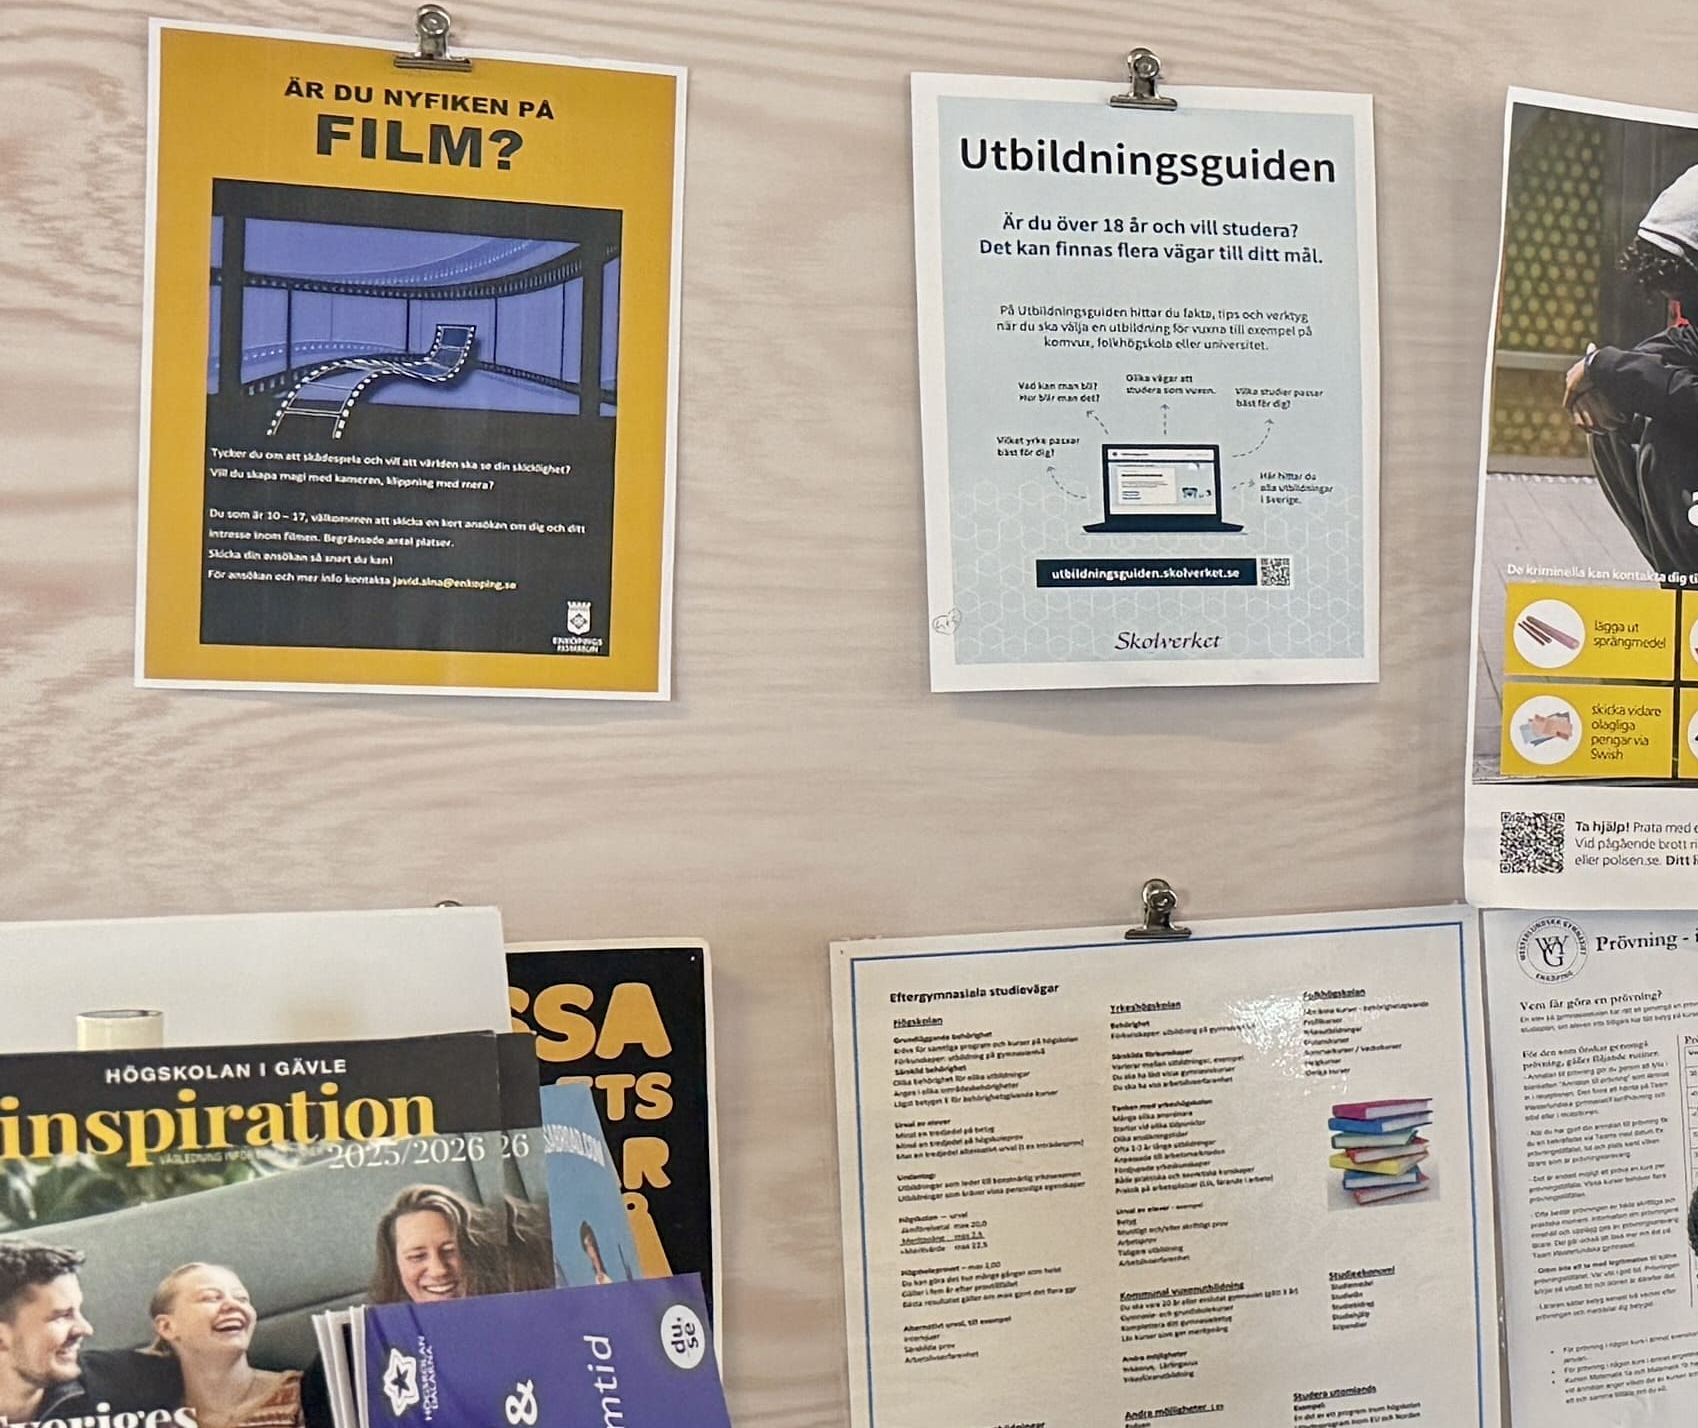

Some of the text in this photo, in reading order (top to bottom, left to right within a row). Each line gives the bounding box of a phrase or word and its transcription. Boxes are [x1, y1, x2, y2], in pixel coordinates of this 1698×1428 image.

[284, 75, 554, 120] ÄR DU NYFIKEN PÅ
[316, 112, 524, 171] FILM?
[960, 137, 1335, 187] Utbildningsguiden
[1002, 211, 1298, 238] Är du över 18 år och vill studera?
[979, 238, 1323, 264] Det kan finnas flera vägar till ditt mål.
[1051, 566, 1240, 581] utbildningsguiden.skolverket.se
[1114, 630, 1220, 650] Skolverket
[1595, 931, 1678, 952] Prövning
[889, 983, 1059, 1004] Eftergymnasiala studievägar
[105, 1057, 347, 1084] HÖGSKOLAN I GÄVLE
[0, 1082, 436, 1168] inspiration
[327, 1137, 485, 1171] 2025/2026
[505, 1379, 538, 1426] &
